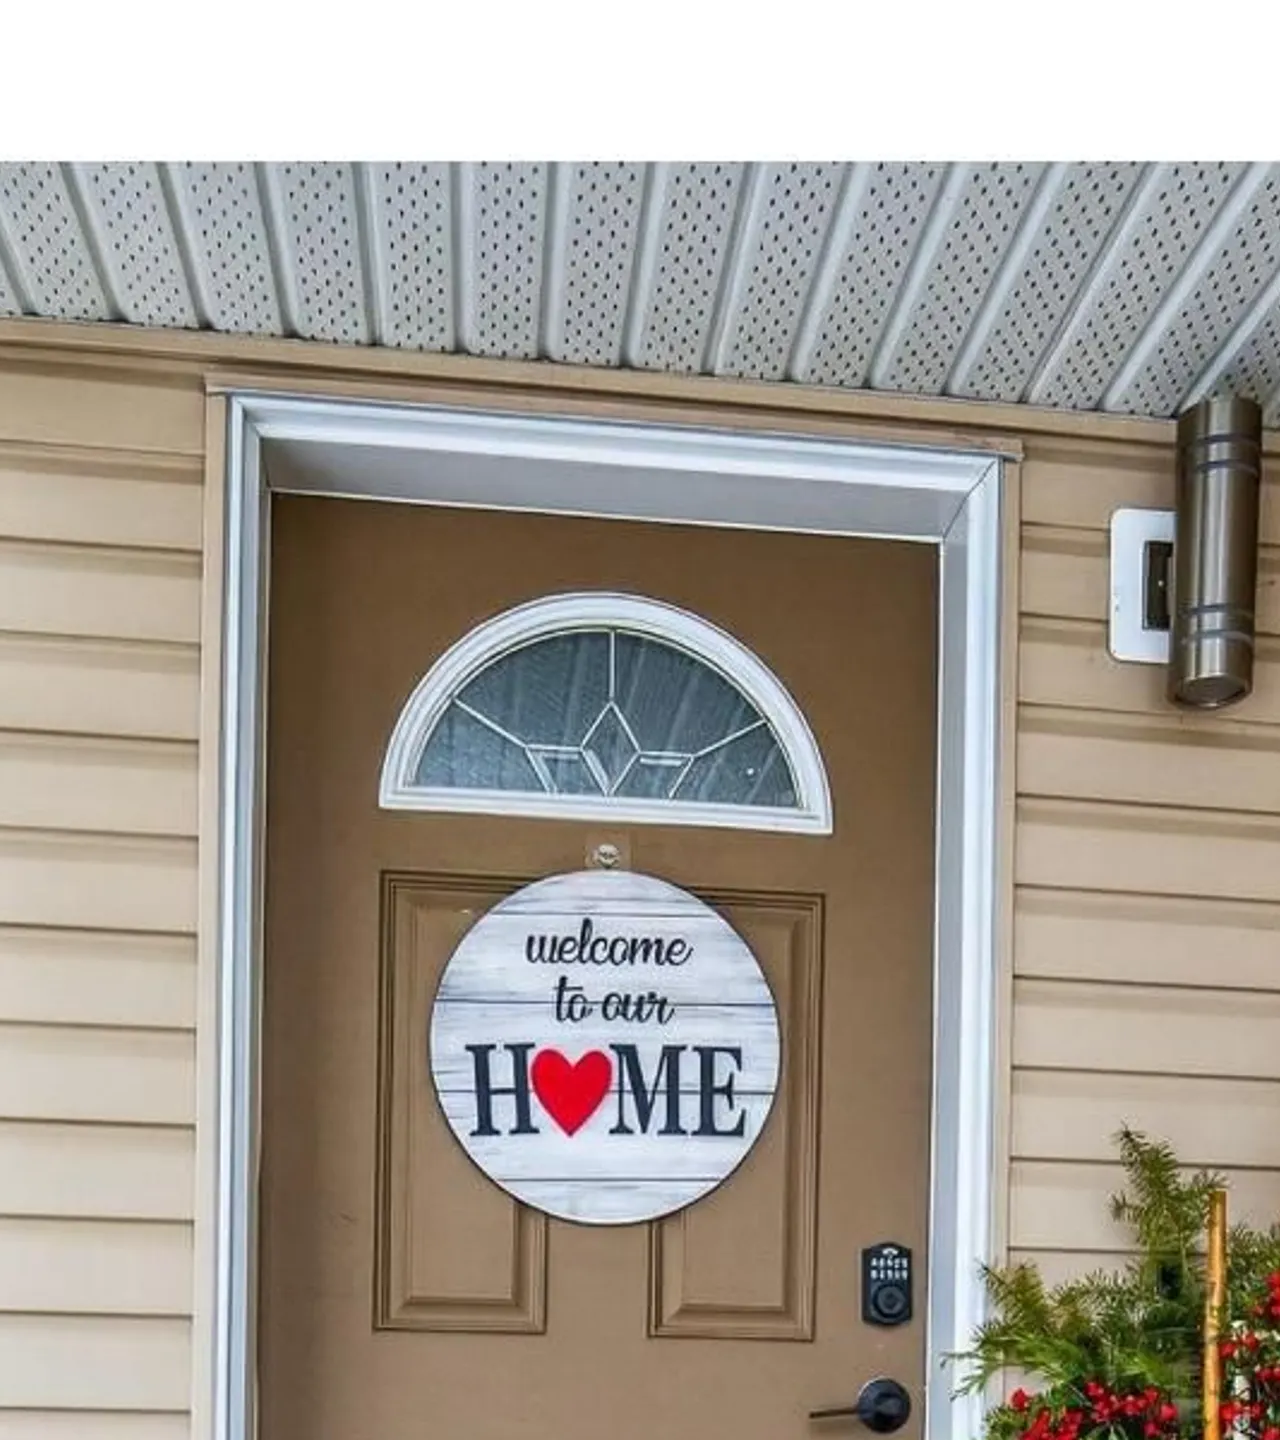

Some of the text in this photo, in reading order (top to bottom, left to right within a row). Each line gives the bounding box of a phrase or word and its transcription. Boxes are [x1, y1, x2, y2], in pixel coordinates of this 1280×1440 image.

[526, 918, 694, 967] welcome
[553, 975, 675, 1025] to our
